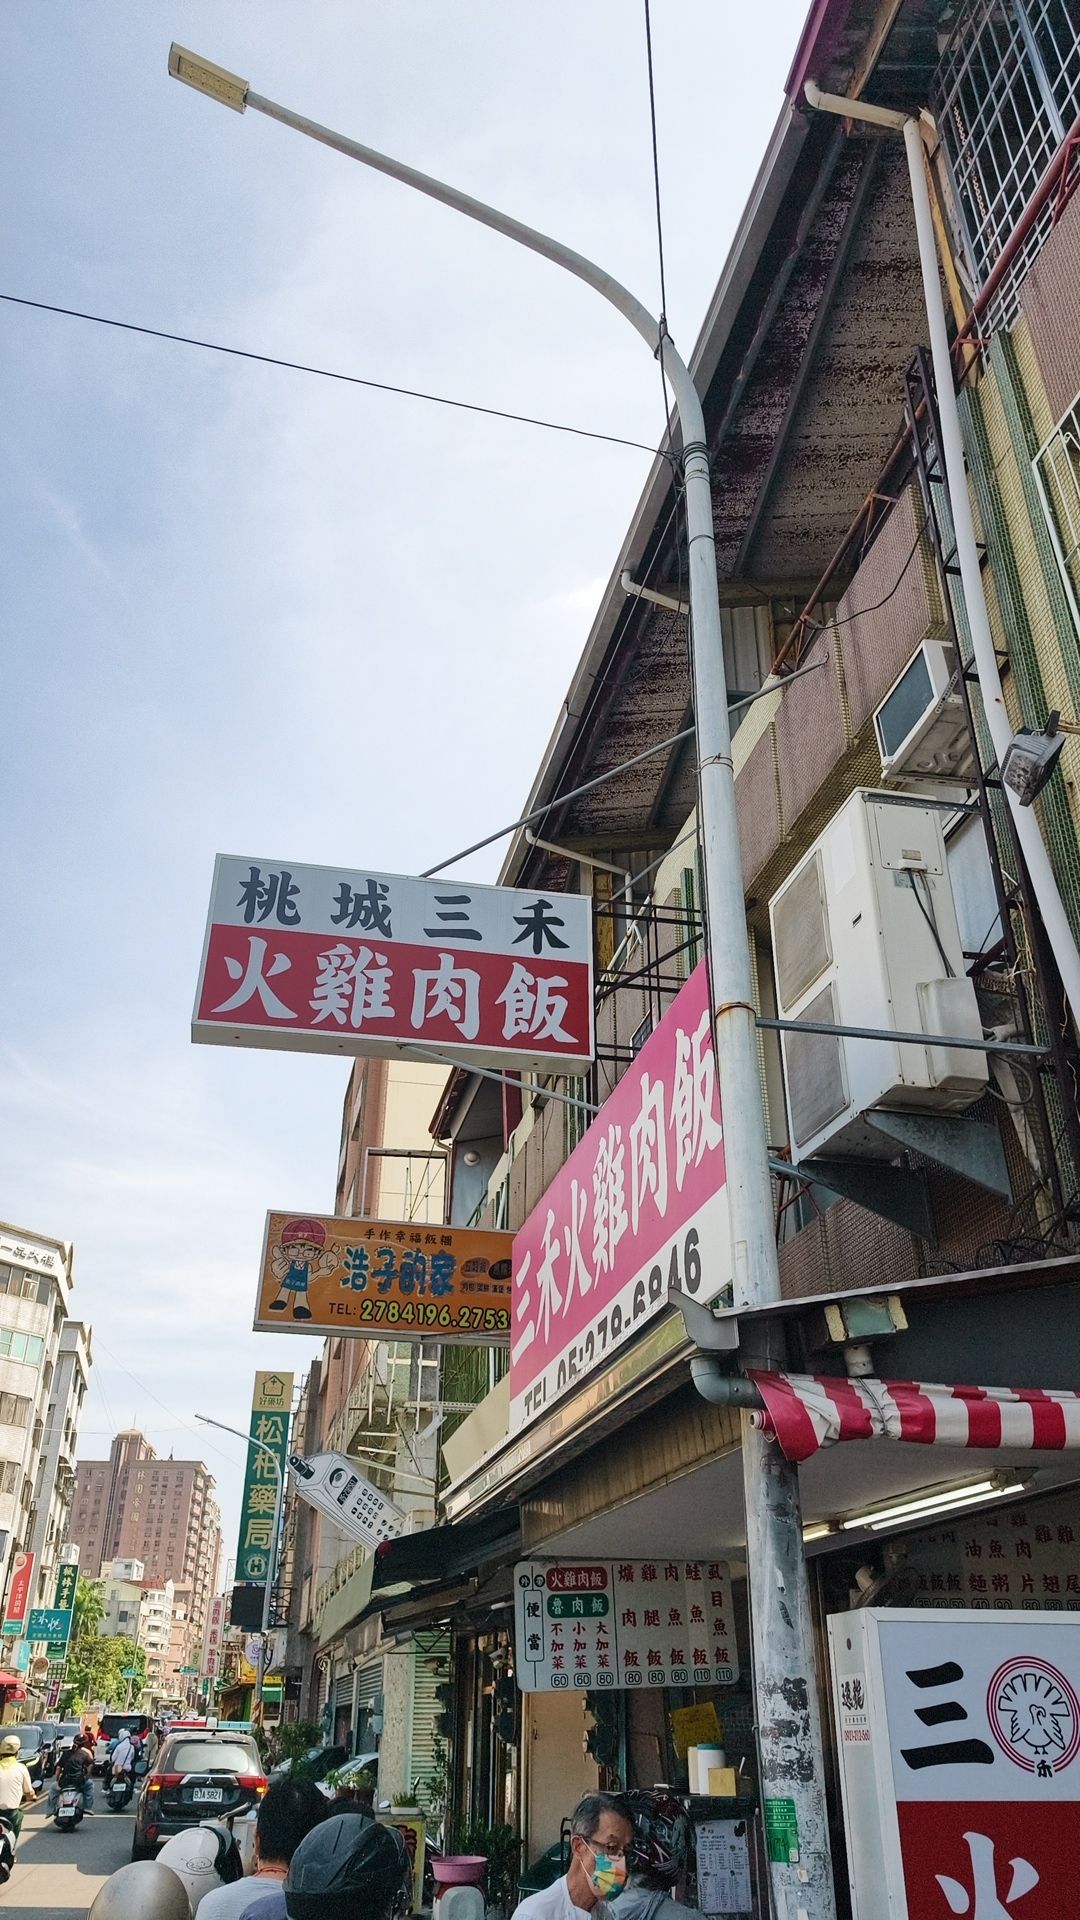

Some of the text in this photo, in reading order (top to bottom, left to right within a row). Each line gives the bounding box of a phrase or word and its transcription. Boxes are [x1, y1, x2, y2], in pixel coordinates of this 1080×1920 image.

[236, 866, 571, 955] 桃城三禾
[210, 935, 580, 1044] 火雞肉飯
[511, 1009, 723, 1368] 三禾火雞肉飯
[363, 1229, 453, 1247] 手作幸福飯糰
[340, 1245, 457, 1298] 浩子的家
[329, 1298, 512, 1330] TEL: 2784196.2753
[244, 1414, 284, 1550] 松柏藥局
[551, 1570, 603, 1588] 火雞肉飯
[551, 1597, 604, 1615] 魯肉飯
[526, 1601, 542, 1651] 便當
[550, 1623, 565, 1670] 不加菜
[572, 1622, 588, 1669] 小加菜
[595, 1621, 610, 1669] 大加菜
[554, 1676, 567, 1685] 60
[576, 1675, 590, 1685] 60
[599, 1674, 612, 1684] 80
[627, 1673, 641, 1683] 80
[650, 1672, 664, 1682] 80
[673, 1671, 686, 1681] 80
[696, 1670, 709, 1680] 110
[717, 1669, 731, 1679] 110
[900, 1660, 995, 1770] 三
[934, 1831, 1040, 1920] 火
